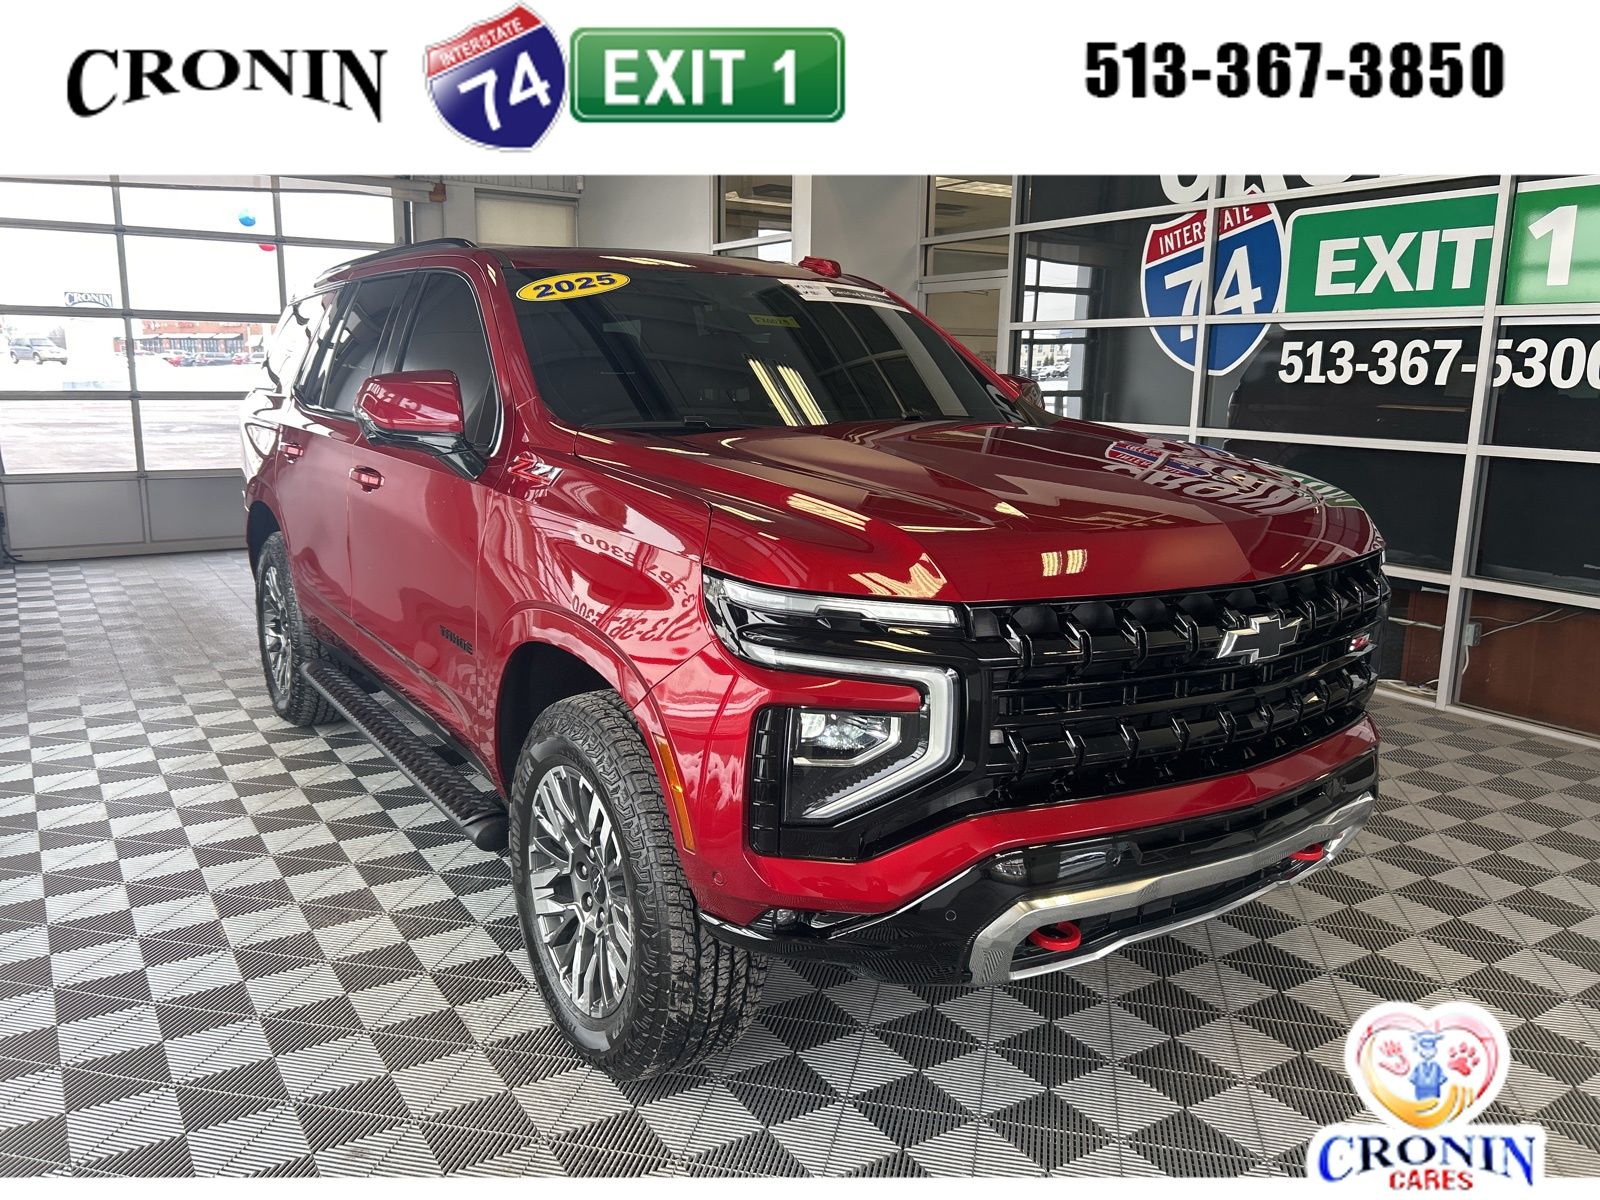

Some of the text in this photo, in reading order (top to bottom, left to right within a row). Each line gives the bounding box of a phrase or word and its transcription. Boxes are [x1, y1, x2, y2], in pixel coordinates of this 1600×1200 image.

[1314, 204, 1578, 296] EXIT 1
[64, 292, 113, 308] CRONIN
[532, 274, 617, 299] 2025
[1164, 245, 1263, 343] 74
